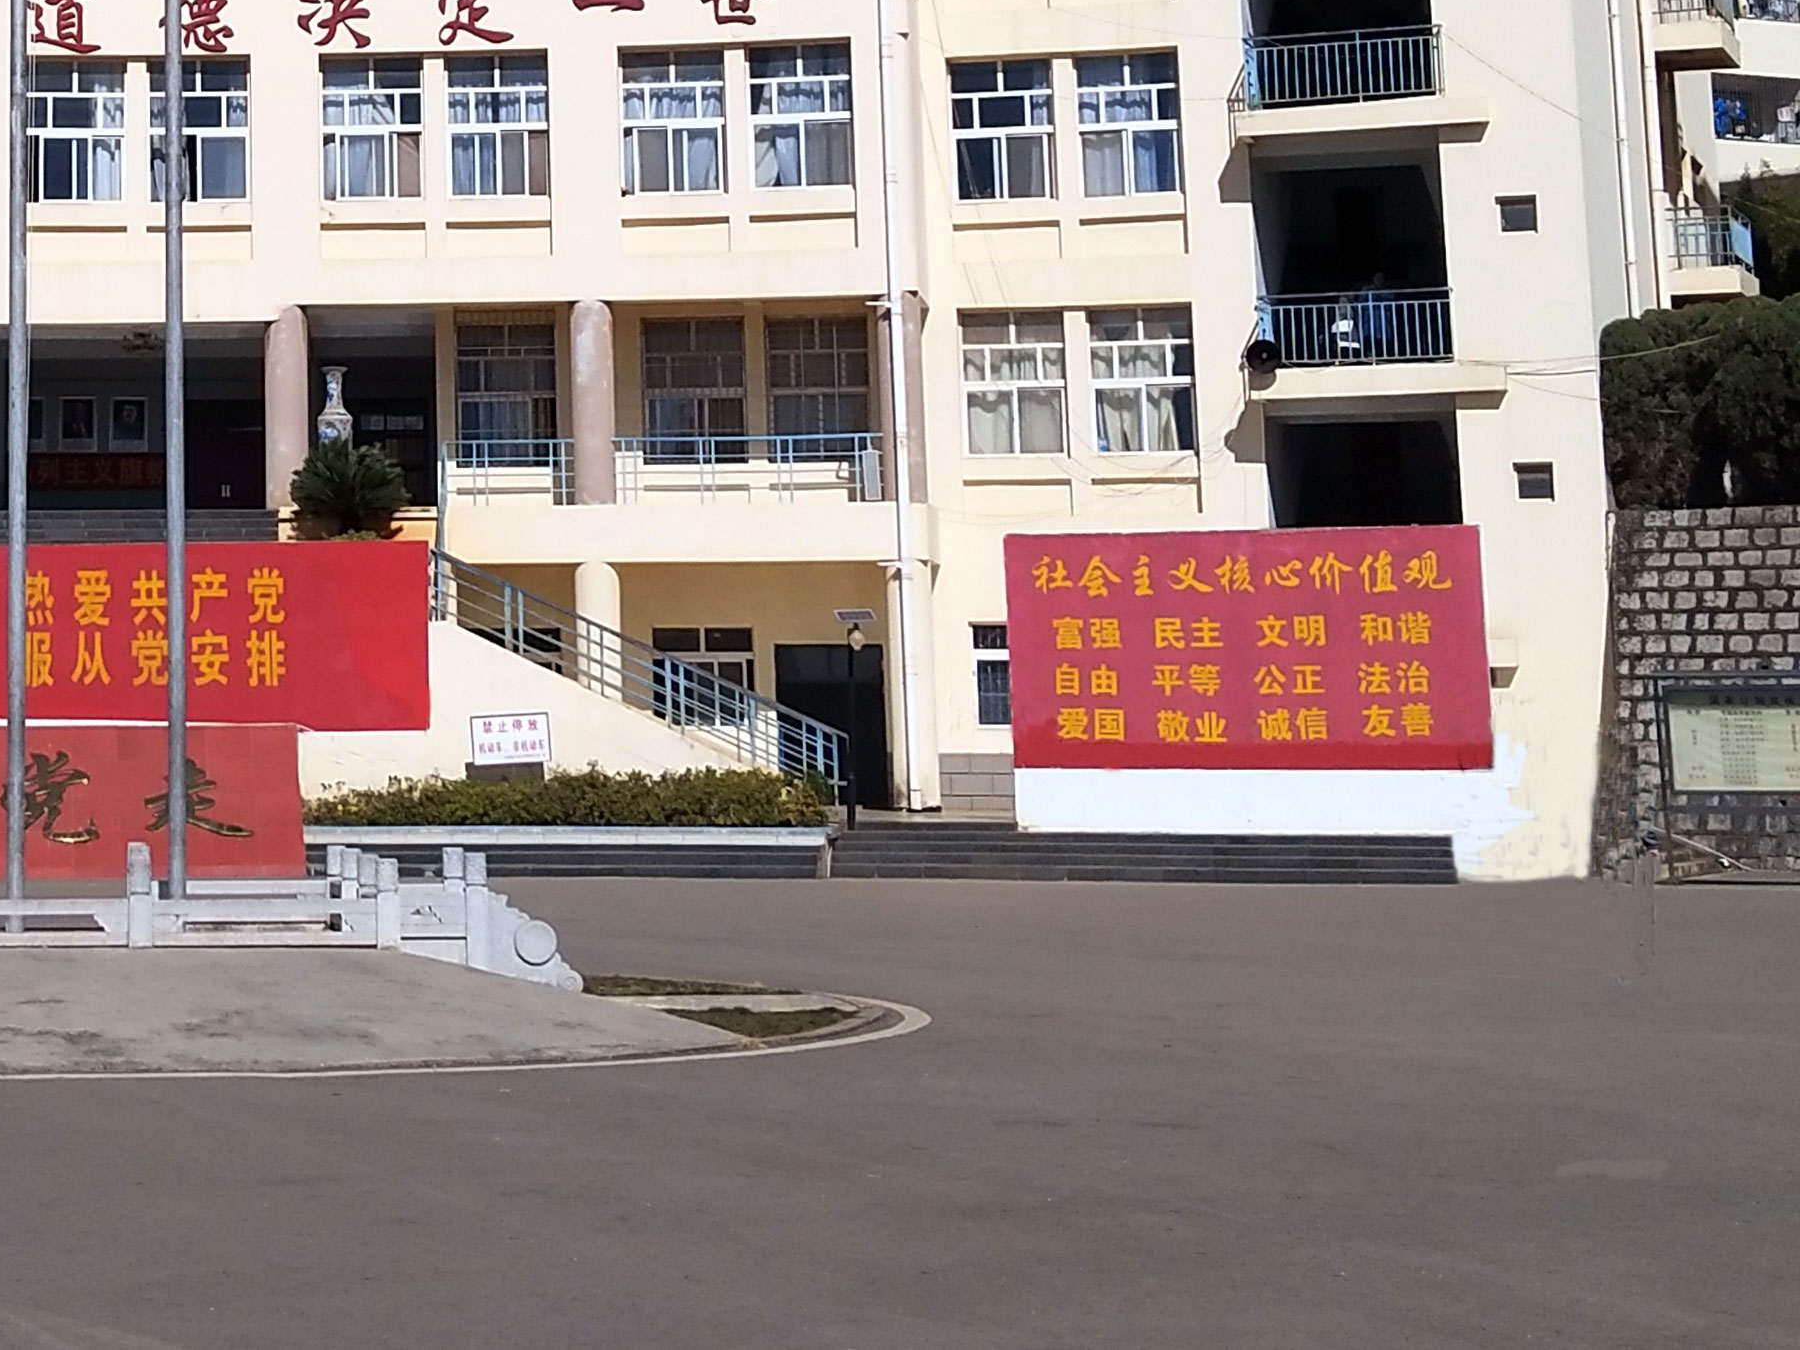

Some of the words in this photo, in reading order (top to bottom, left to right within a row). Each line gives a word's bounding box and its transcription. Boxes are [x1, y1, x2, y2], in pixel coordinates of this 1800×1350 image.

[1032, 550, 1452, 598] 社会主义核心价值观
[25, 567, 286, 627] 热爱共产党
[1052, 617, 1121, 650] 富强
[1153, 617, 1224, 649] 民主
[1256, 614, 1327, 647] 文明
[1360, 611, 1433, 645] 和谐
[25, 628, 287, 688] 服从党安排
[1054, 663, 1119, 696] 自由
[1152, 664, 1221, 697] 平等
[1254, 664, 1325, 695] 公正
[1358, 660, 1430, 695] 法治
[1057, 707, 1126, 742] 爱国
[1157, 710, 1228, 744] 敬业
[1257, 708, 1329, 741] 诚信
[1362, 702, 1434, 737] 友善
